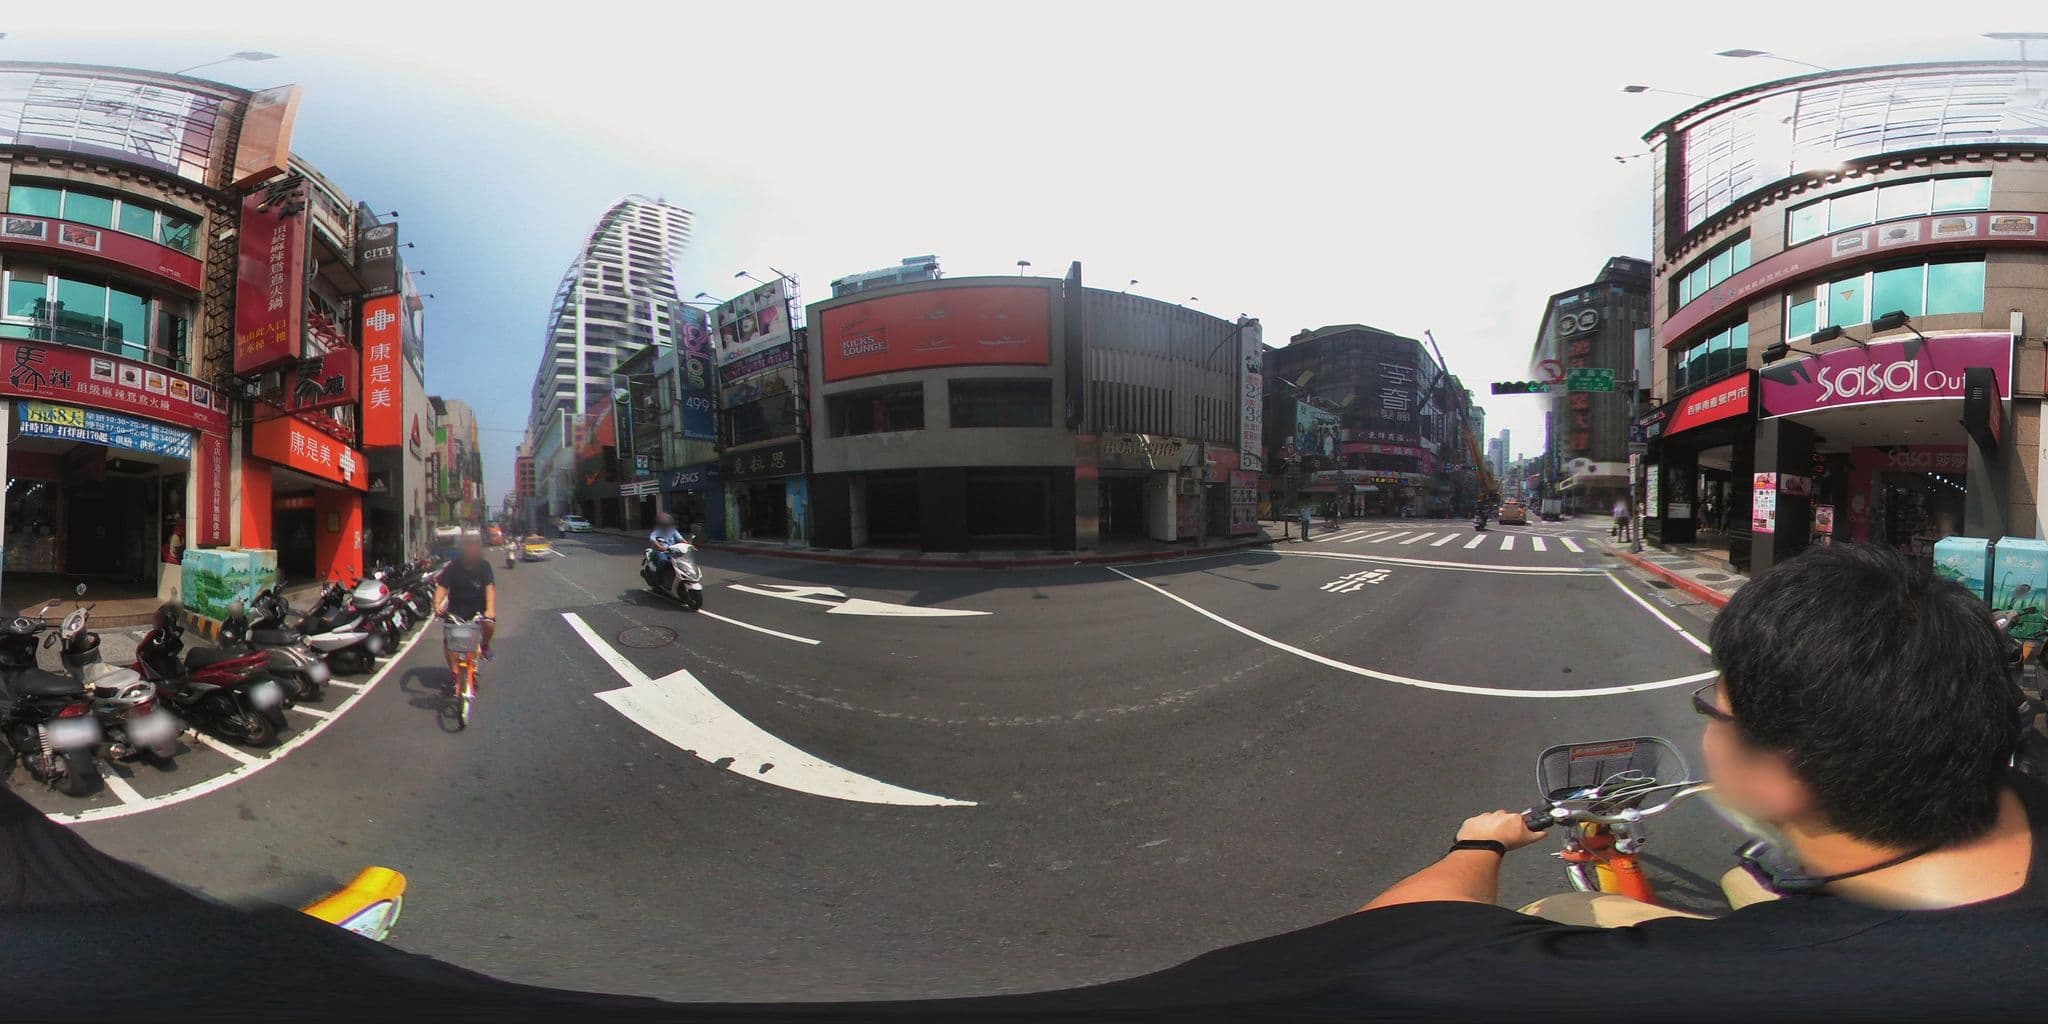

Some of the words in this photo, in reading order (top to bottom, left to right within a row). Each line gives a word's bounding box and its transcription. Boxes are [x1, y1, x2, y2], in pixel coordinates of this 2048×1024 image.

[364, 246, 394, 260] CITY
[842, 335, 874, 349] KICKS
[843, 342, 886, 356] LOUNGE
[370, 343, 392, 408] 康是美
[77, 381, 170, 411] 頂級麻辣鴛鴦火鍋
[290, 430, 332, 469] 康是美
